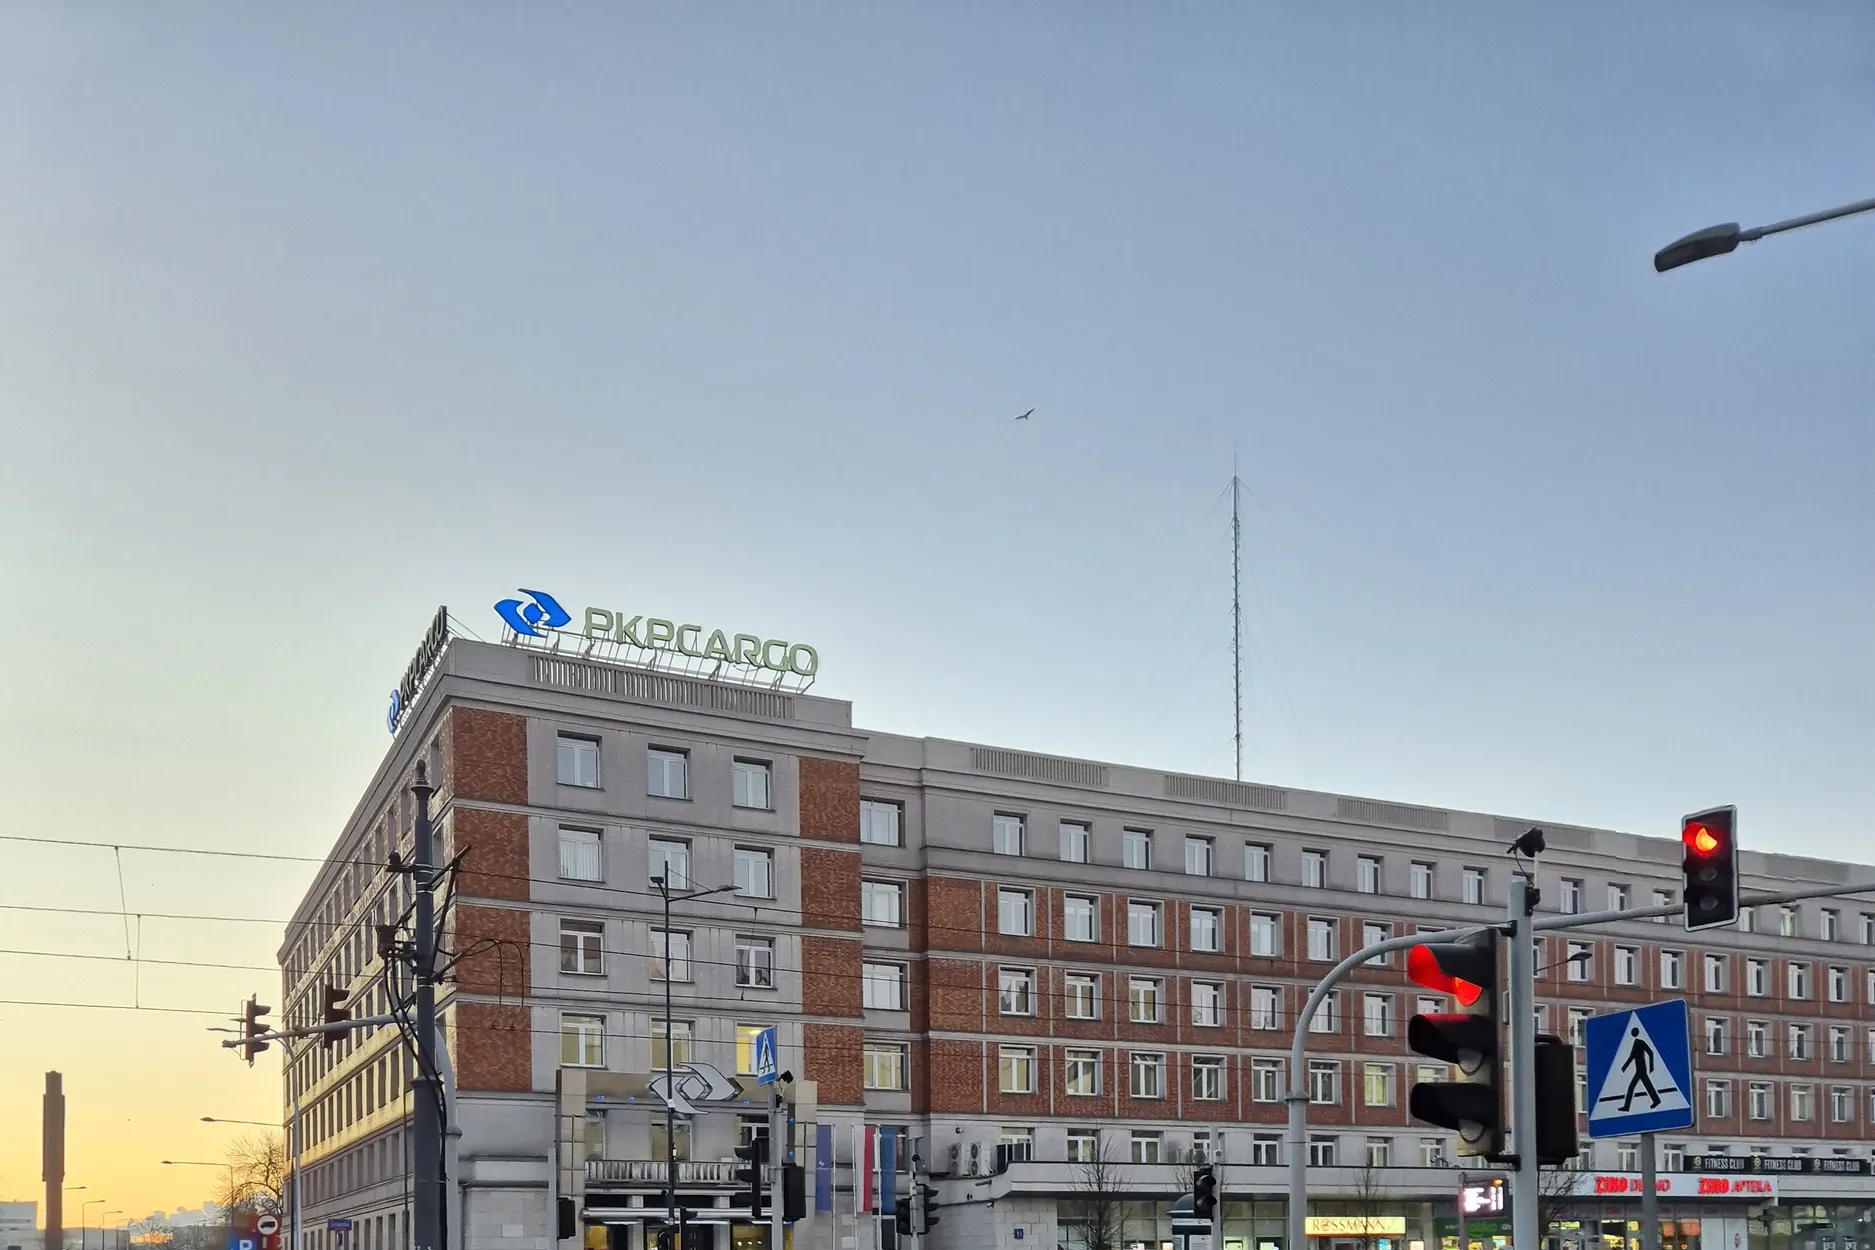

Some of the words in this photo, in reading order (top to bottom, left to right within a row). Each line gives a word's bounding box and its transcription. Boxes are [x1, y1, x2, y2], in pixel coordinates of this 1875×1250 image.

[1704, 1158, 1728, 1169] FITNESS
[1729, 1158, 1744, 1170] CLUB
[1764, 1159, 1786, 1170] FITNESS
[1787, 1159, 1802, 1171] CLUB
[1823, 1160, 1845, 1171] FITNESS
[1845, 1160, 1860, 1172] CLUB
[1732, 1179, 1772, 1193] APTEKA
[1312, 1218, 1386, 1232] ROSSMANN
